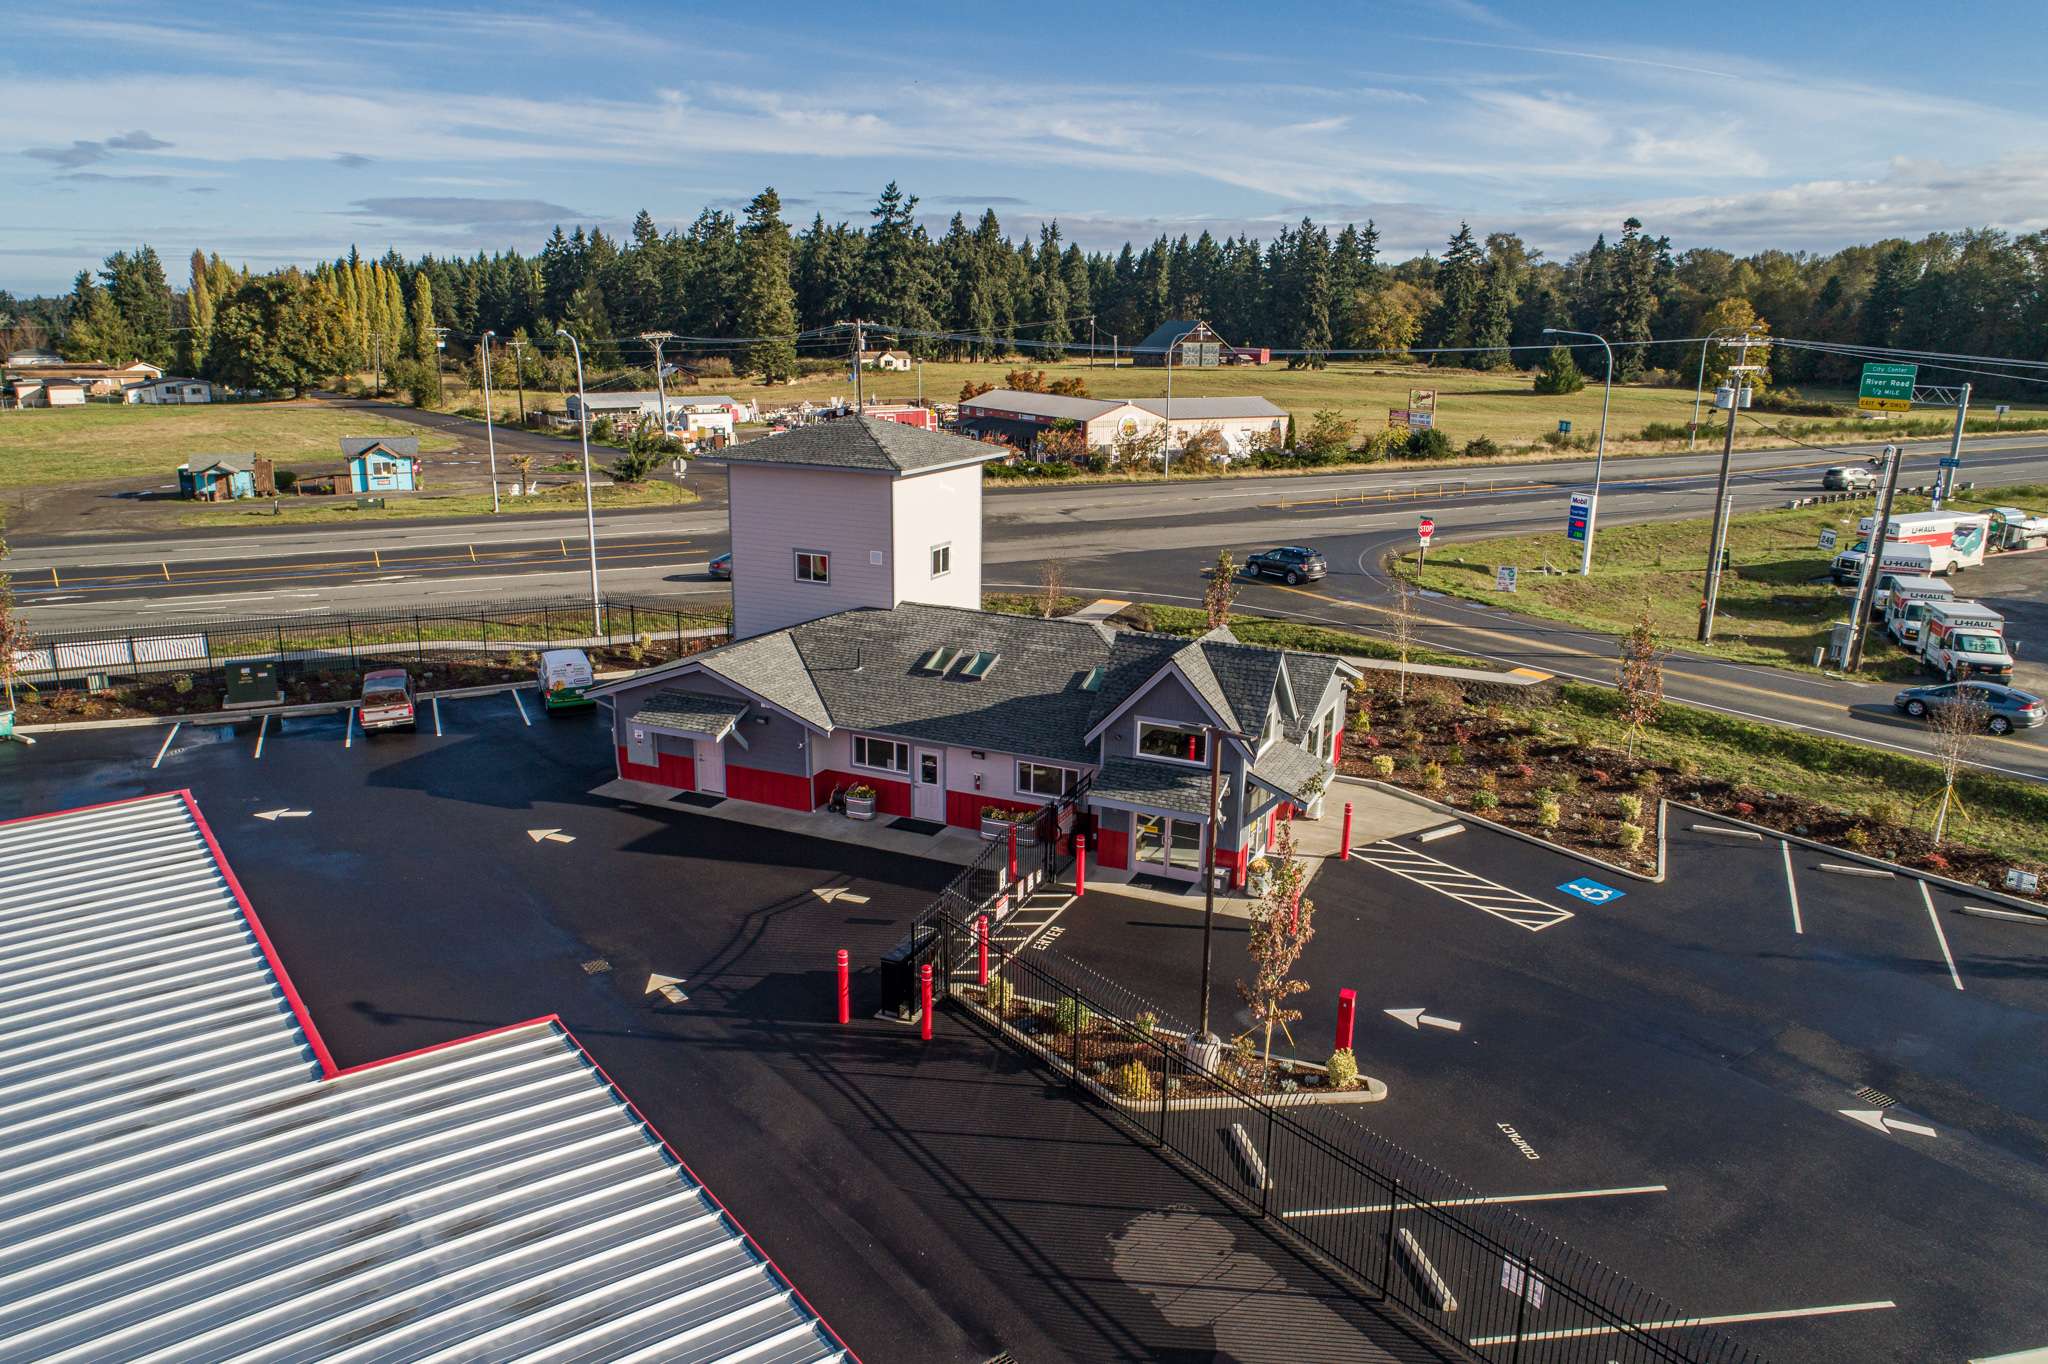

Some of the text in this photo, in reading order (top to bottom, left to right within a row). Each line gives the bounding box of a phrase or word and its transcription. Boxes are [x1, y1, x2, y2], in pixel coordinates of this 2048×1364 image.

[1865, 378, 1910, 387] River Road
[1572, 496, 1588, 505] Mobil
[1419, 525, 1433, 533] STOP
[1911, 526, 1937, 534] U-HAUL
[1883, 560, 1924, 569] U-HAUL
[1910, 592, 1946, 600] U-HAUL
[1954, 619, 1995, 628] U-HAUL
[1032, 926, 1067, 951] ENTER
[1496, 1122, 1540, 1160] COMPACT
